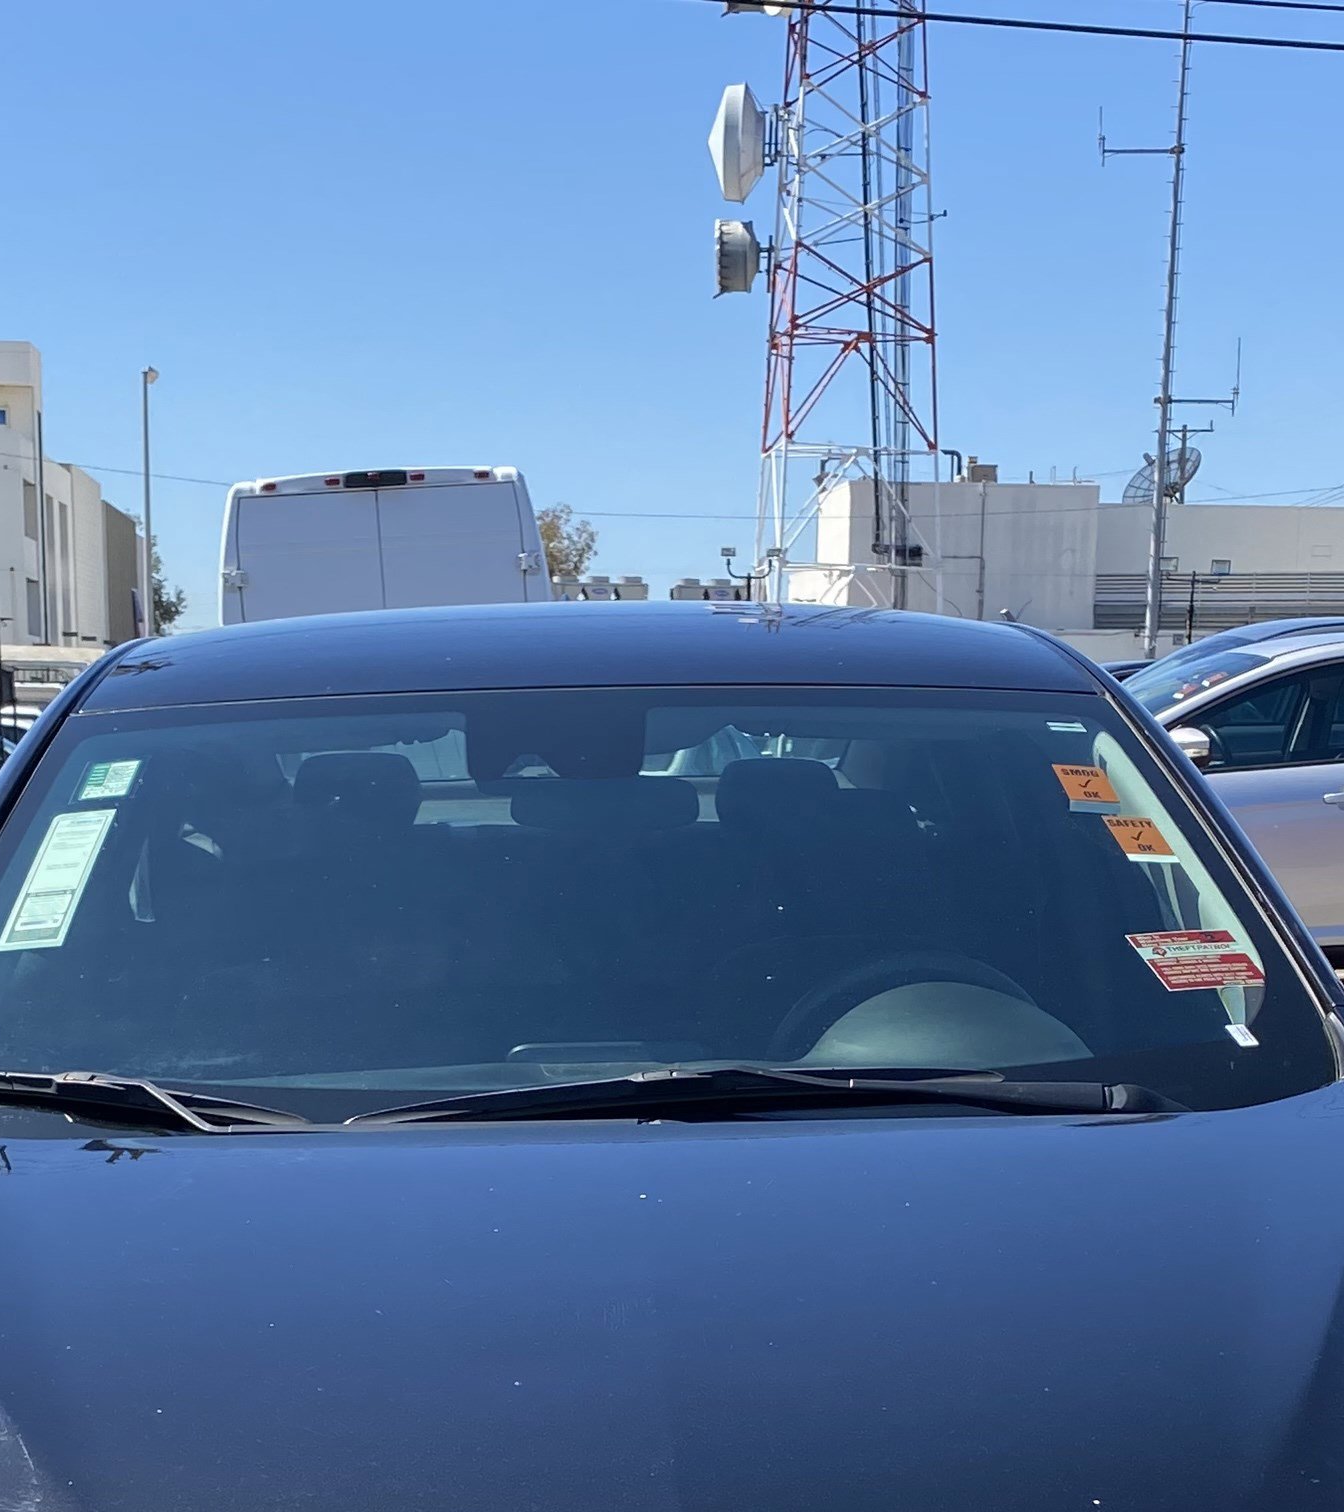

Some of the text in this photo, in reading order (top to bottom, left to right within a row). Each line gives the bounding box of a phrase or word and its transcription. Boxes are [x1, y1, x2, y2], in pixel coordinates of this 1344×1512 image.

[1061, 768, 1100, 777] SMOG
[1083, 791, 1101, 799] OK
[1107, 819, 1152, 828] SAFETY
[1138, 844, 1156, 852] OK
